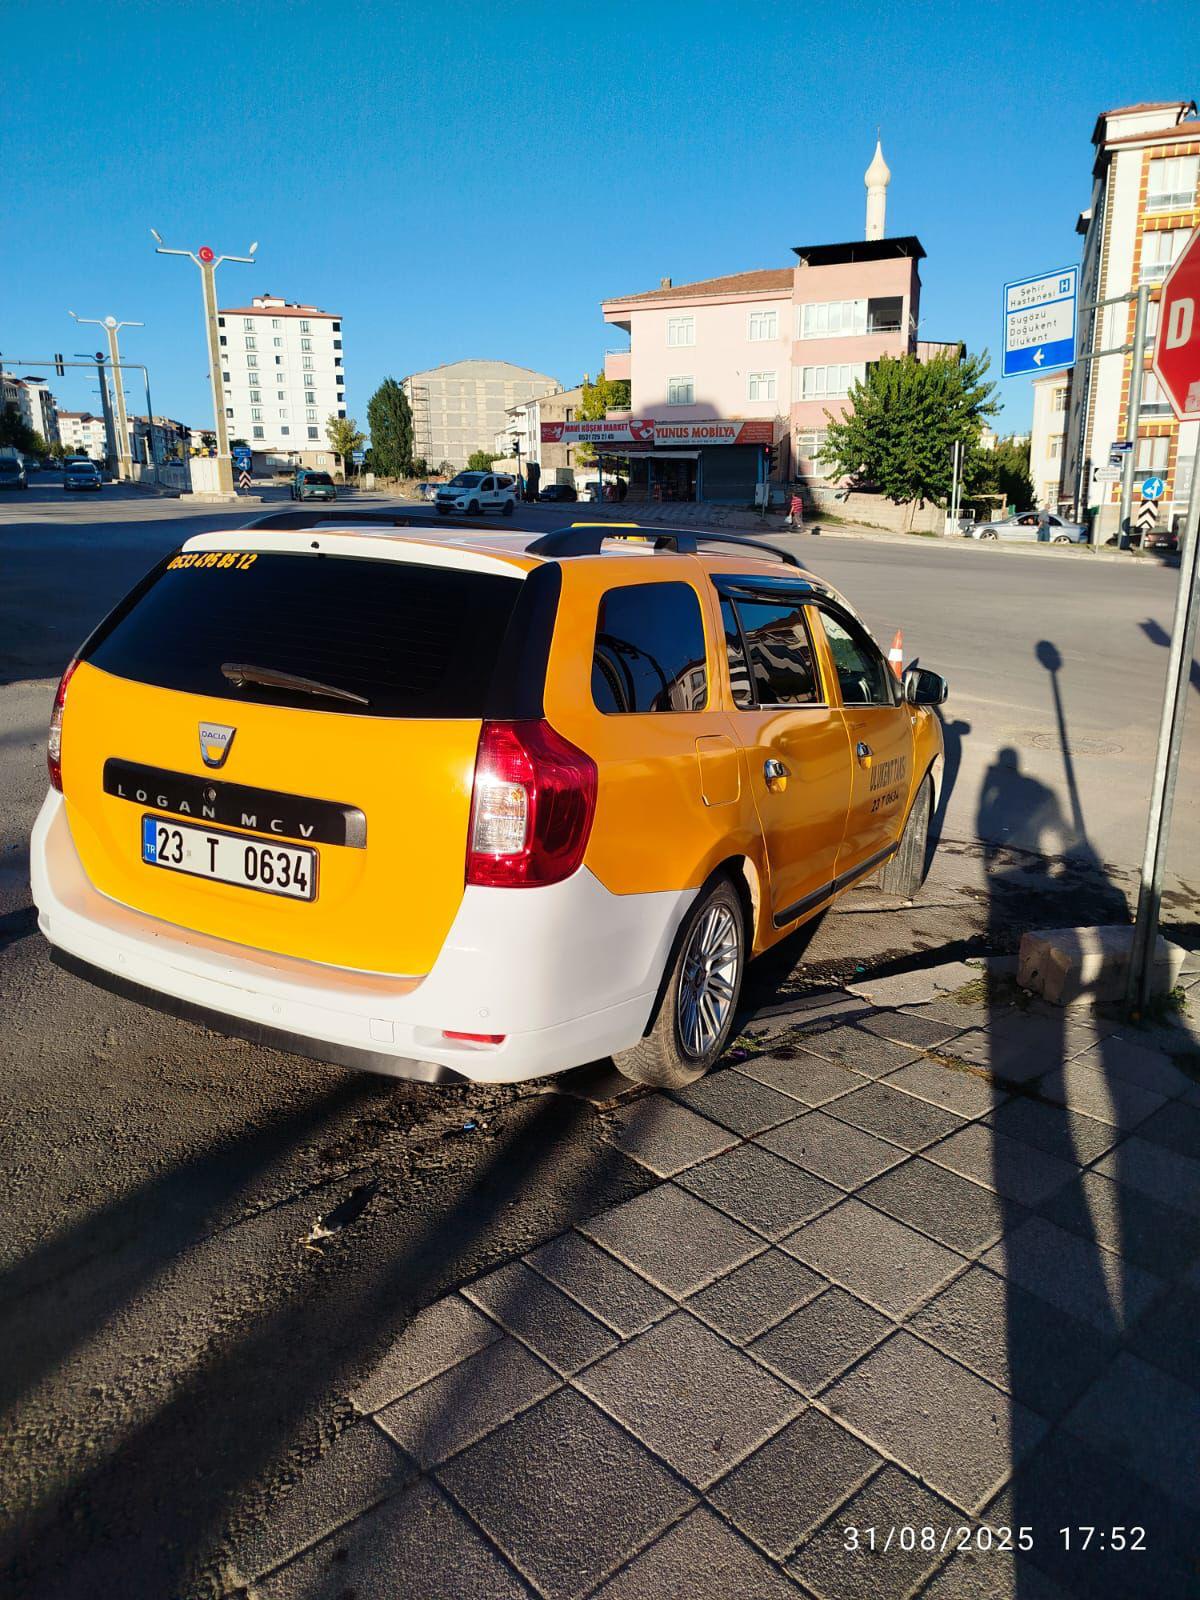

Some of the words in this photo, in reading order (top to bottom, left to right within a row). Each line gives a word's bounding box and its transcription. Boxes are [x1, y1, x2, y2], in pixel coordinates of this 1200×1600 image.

[1010, 291, 1056, 308] Hastanesi
[1010, 320, 1057, 336] Doğukent
[1009, 334, 1048, 347] Ulukent
[604, 423, 628, 432] MARKET
[656, 426, 689, 439] YUNUS
[692, 424, 736, 438] MOBİLYA
[236, 553, 258, 570] 12
[201, 730, 227, 742] DACIA
[117, 784, 216, 819] LOGAN
[241, 814, 315, 838] MCV
[871, 797, 880, 813] 23
[146, 844, 156, 854] TR
[158, 827, 184, 864] 23
[206, 837, 219, 873] T
[244, 846, 308, 892] 0634
